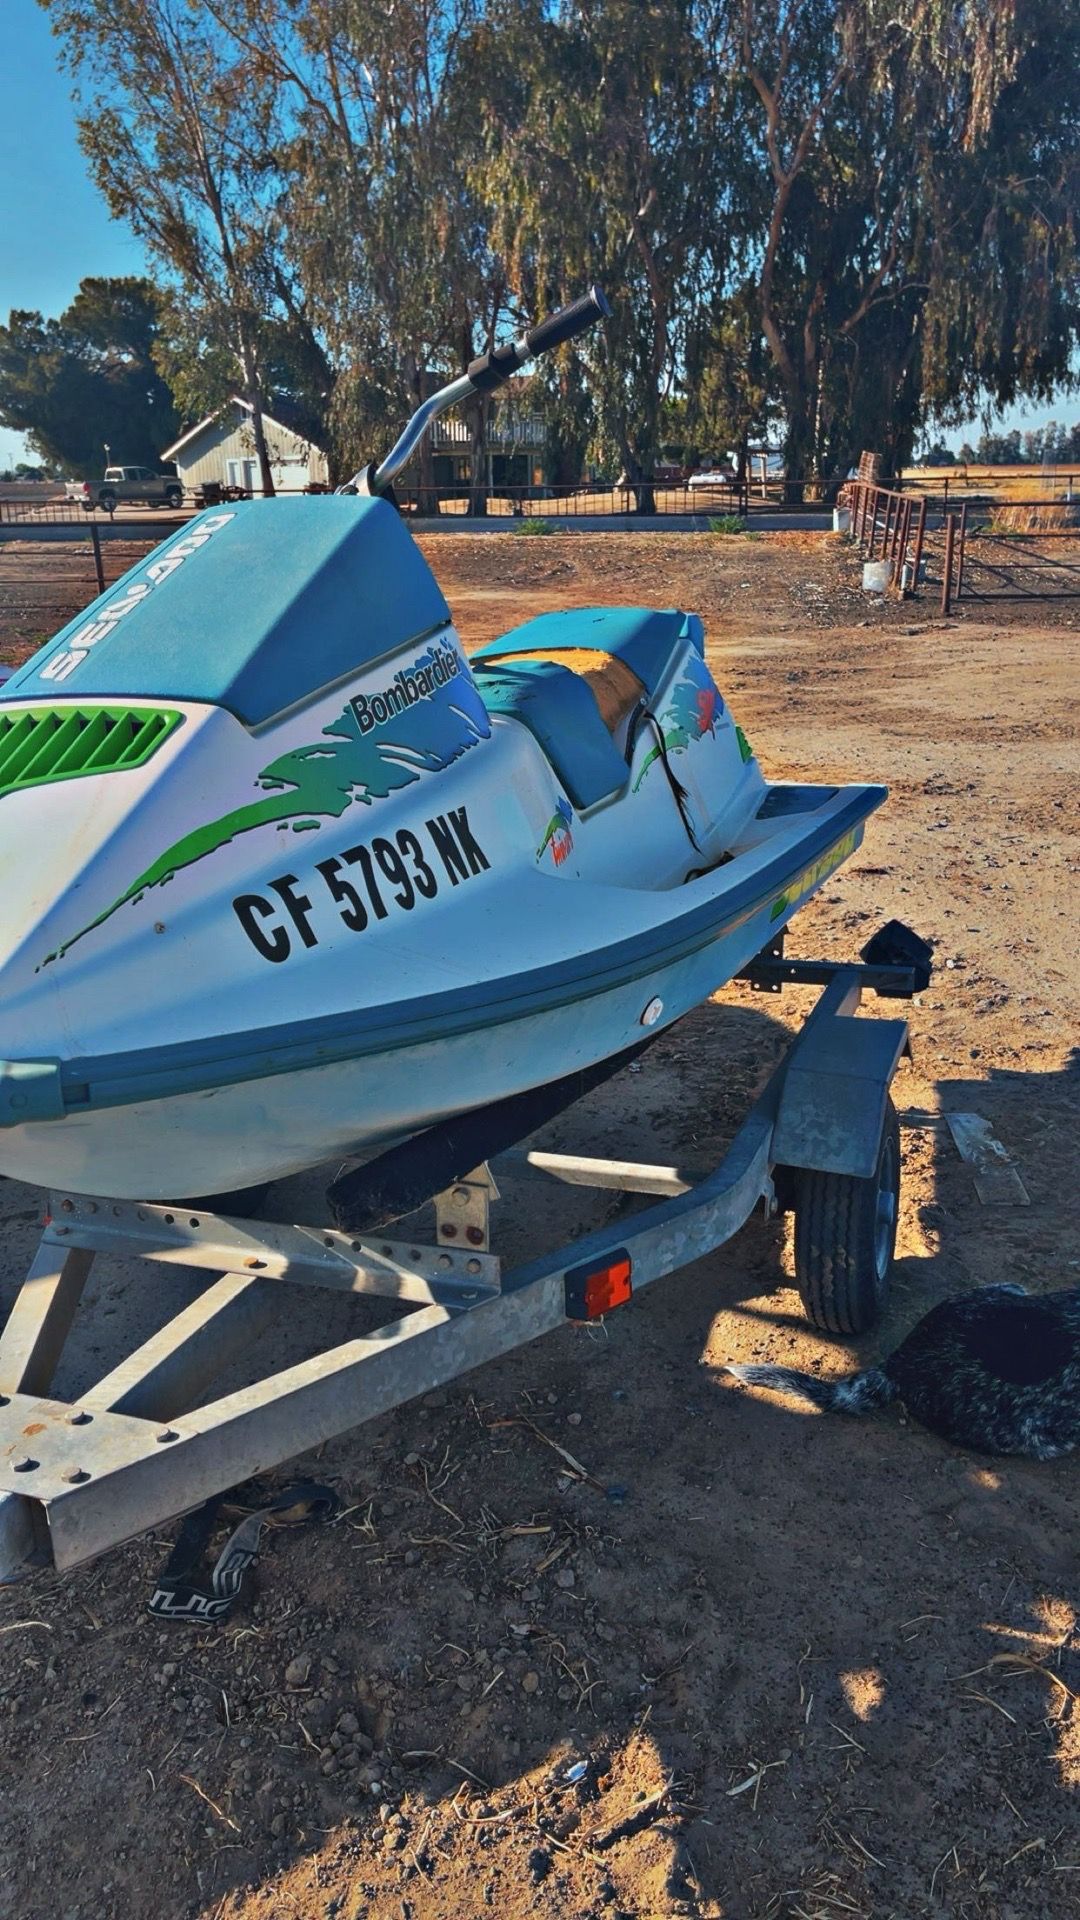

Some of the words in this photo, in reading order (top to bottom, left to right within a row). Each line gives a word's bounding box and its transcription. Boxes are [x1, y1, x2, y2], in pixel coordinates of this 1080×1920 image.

[348, 647, 461, 736] Bombardier
[232, 873, 319, 963] CF
[313, 829, 438, 933] 5793
[424, 805, 492, 887] NK
